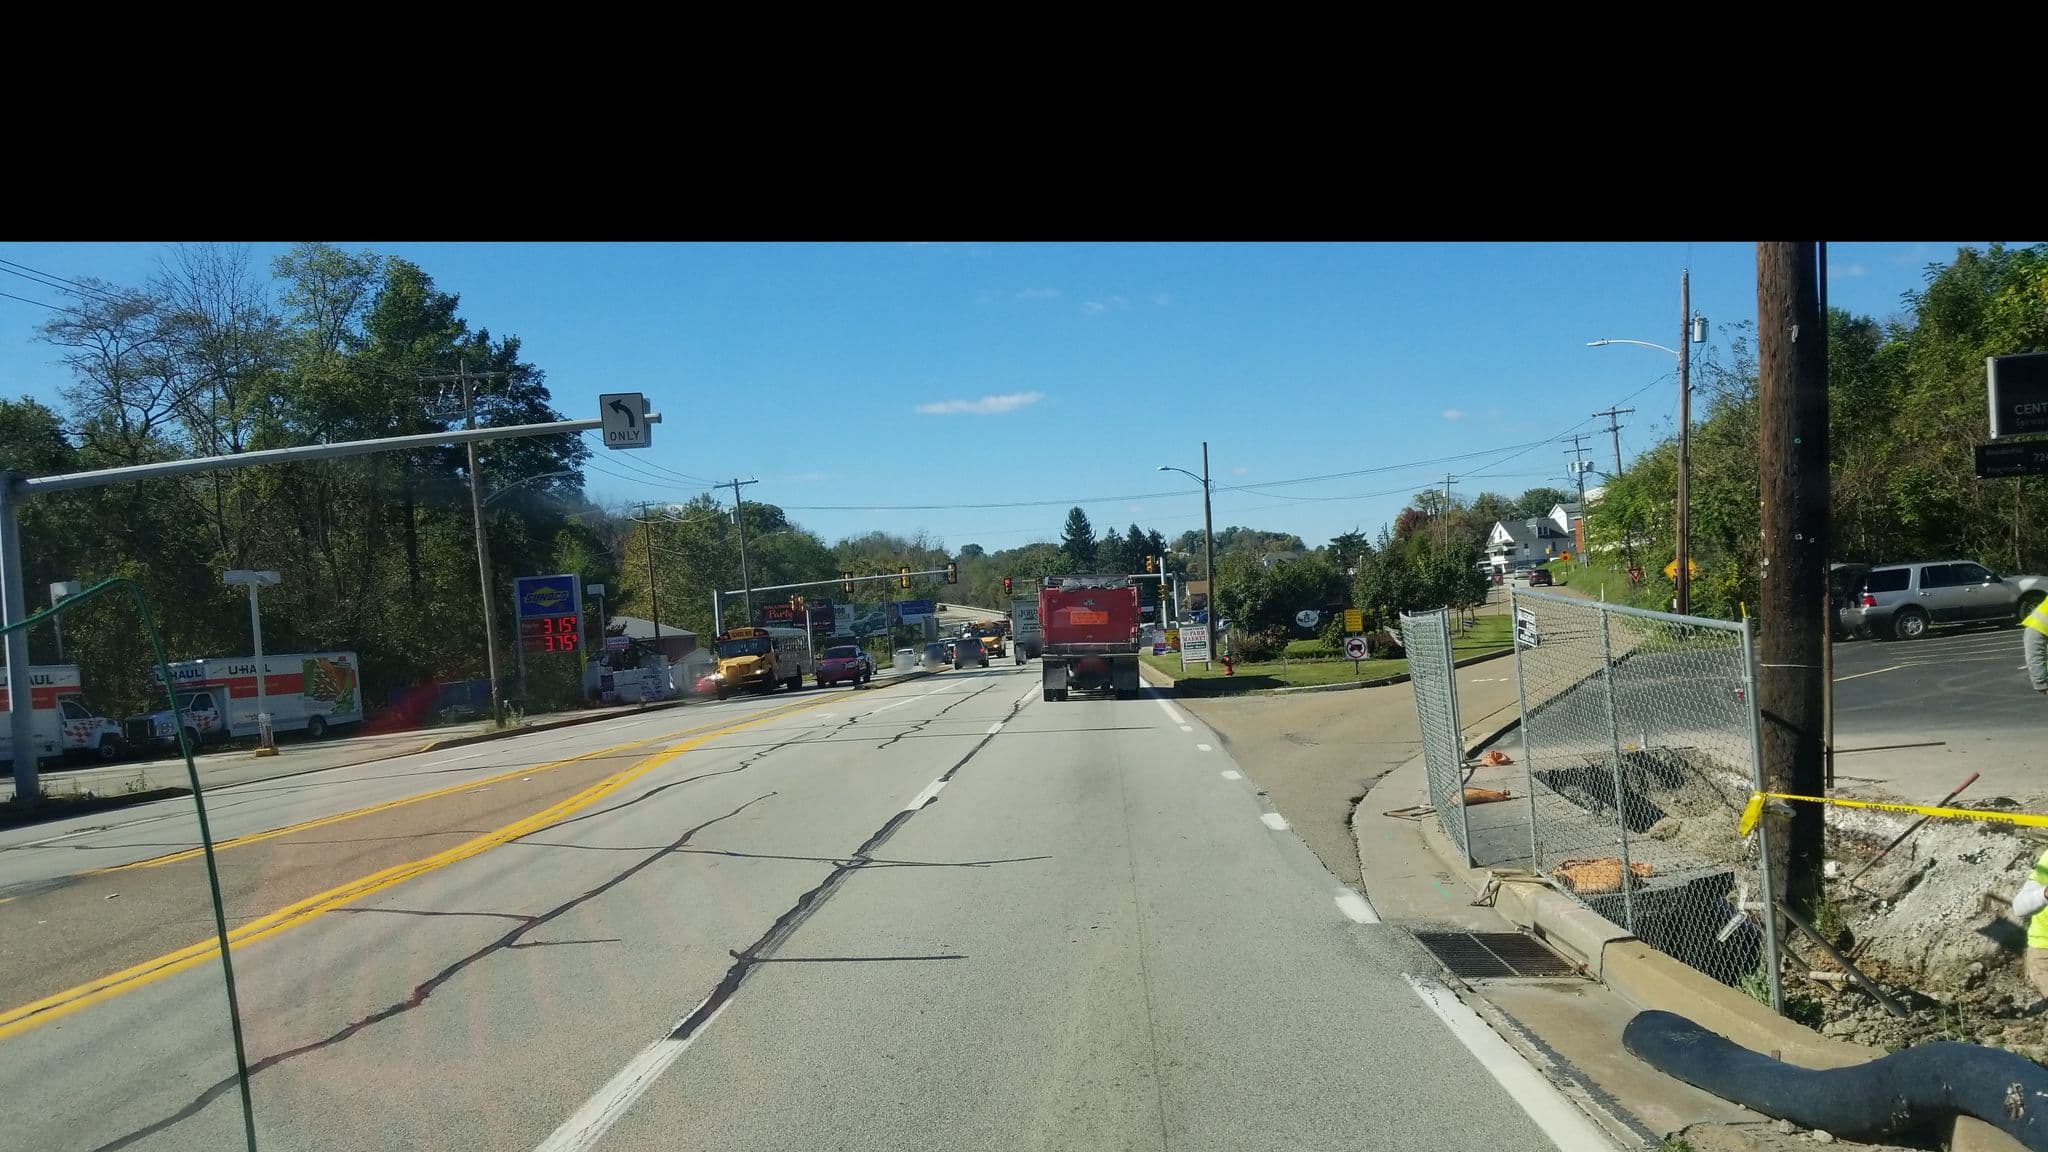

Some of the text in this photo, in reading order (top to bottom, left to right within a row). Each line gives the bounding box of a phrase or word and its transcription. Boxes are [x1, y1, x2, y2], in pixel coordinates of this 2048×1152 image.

[610, 431, 640, 441] ONLY
[527, 591, 568, 602] SUNOCO
[228, 663, 271, 676] U-HAL
